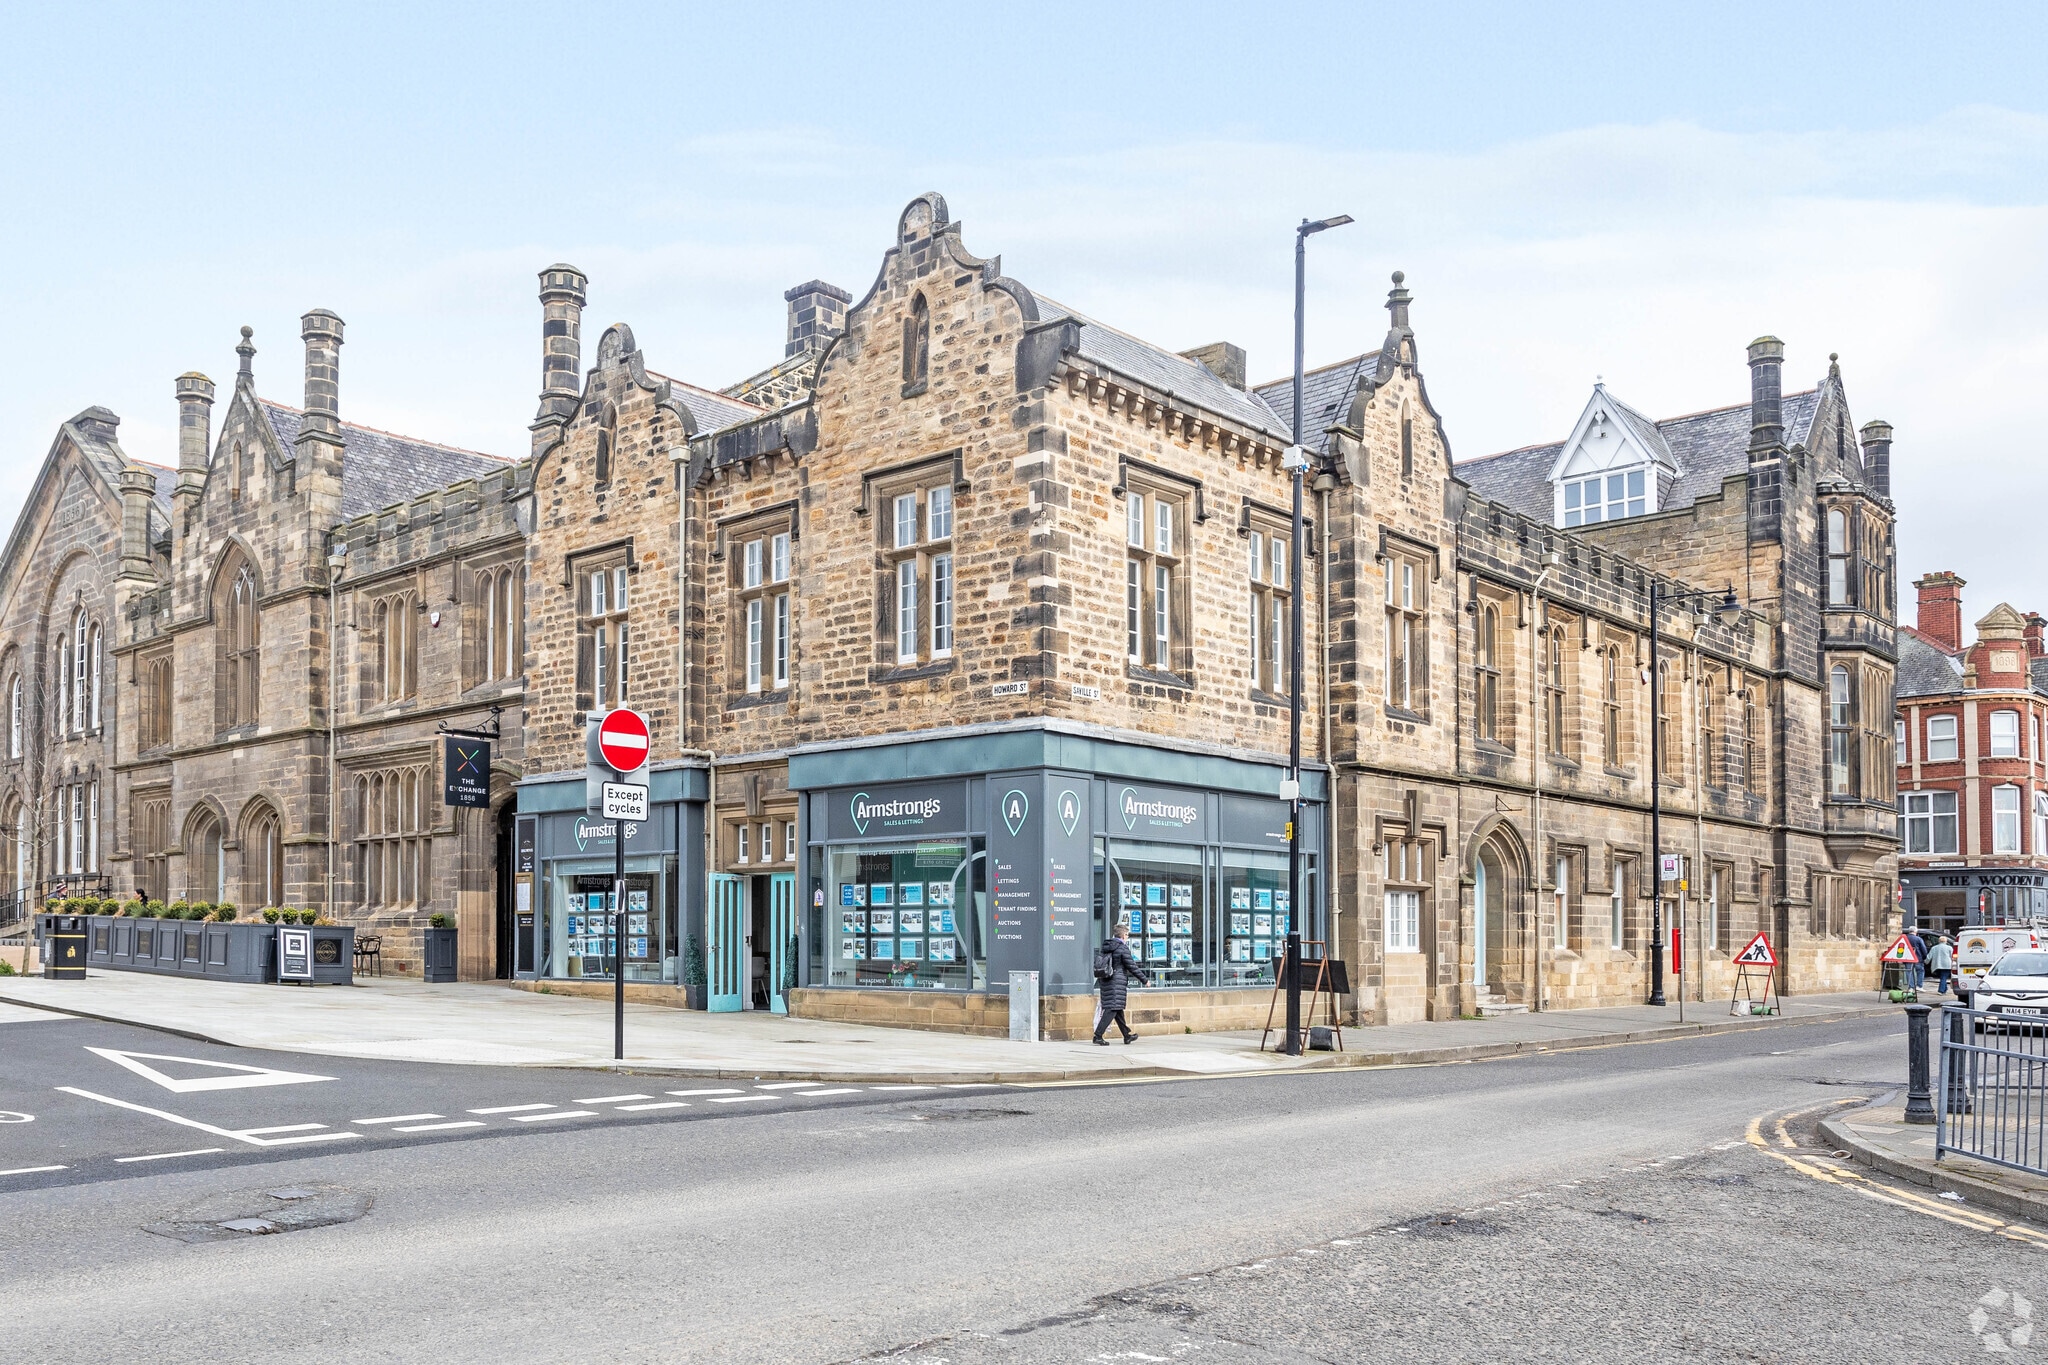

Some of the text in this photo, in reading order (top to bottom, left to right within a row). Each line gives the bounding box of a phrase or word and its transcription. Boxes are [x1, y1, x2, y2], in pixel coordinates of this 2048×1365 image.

[994, 683, 1018, 694] HOWARD
[1073, 686, 1092, 698] SAVILLE
[449, 785, 486, 794] EXCHANGE
[608, 788, 643, 802] Except
[608, 803, 641, 814] cycles
[857, 798, 940, 818] Armstrongs
[1009, 800, 1020, 818] A
[1064, 800, 1074, 818] A
[1125, 796, 1197, 824] Armstrongs
[579, 822, 637, 838] Armstrogs
[1938, 876, 1970, 886] THE
[1978, 875, 2032, 886] WOODEN
